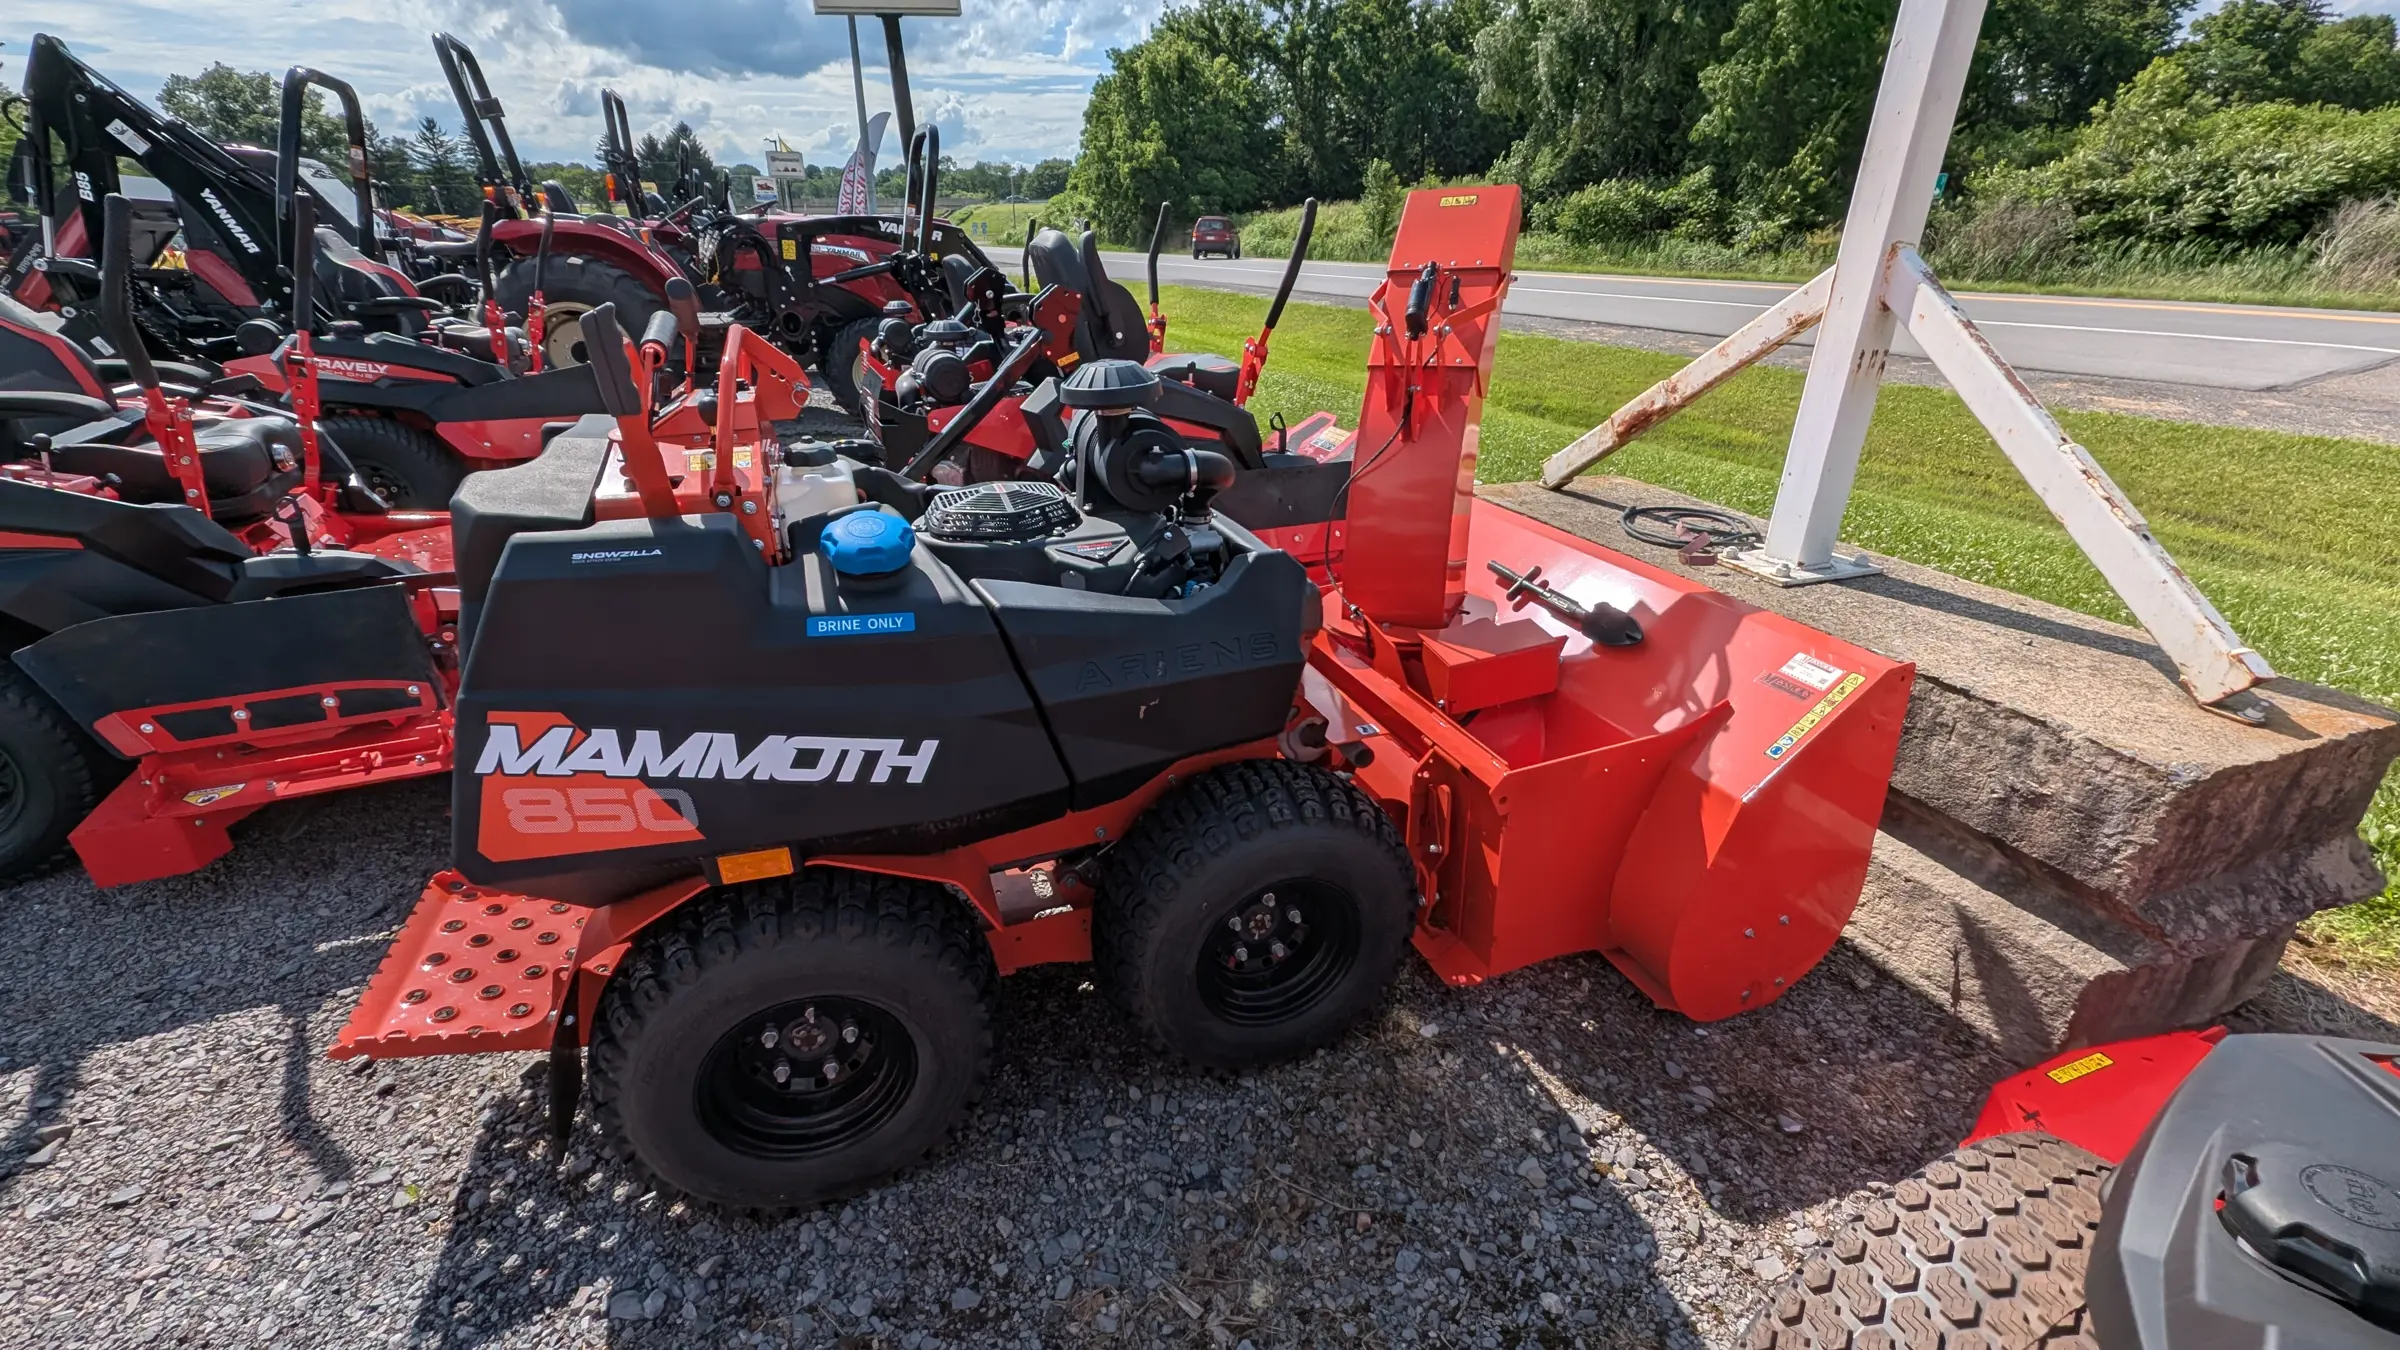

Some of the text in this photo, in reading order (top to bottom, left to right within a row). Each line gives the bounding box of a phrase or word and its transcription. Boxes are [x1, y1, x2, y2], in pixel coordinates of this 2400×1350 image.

[75, 170, 94, 203] B85
[200, 187, 261, 255] YANMAR
[826, 246, 862, 259] YANMAR
[317, 357, 388, 374] RAVELY
[571, 548, 663, 560] SNOWZILLA
[817, 616, 904, 633] BRINE ONLY
[1076, 631, 1279, 693] ARIENS
[474, 724, 940, 784] MAMMOTH
[502, 787, 699, 834] 850
